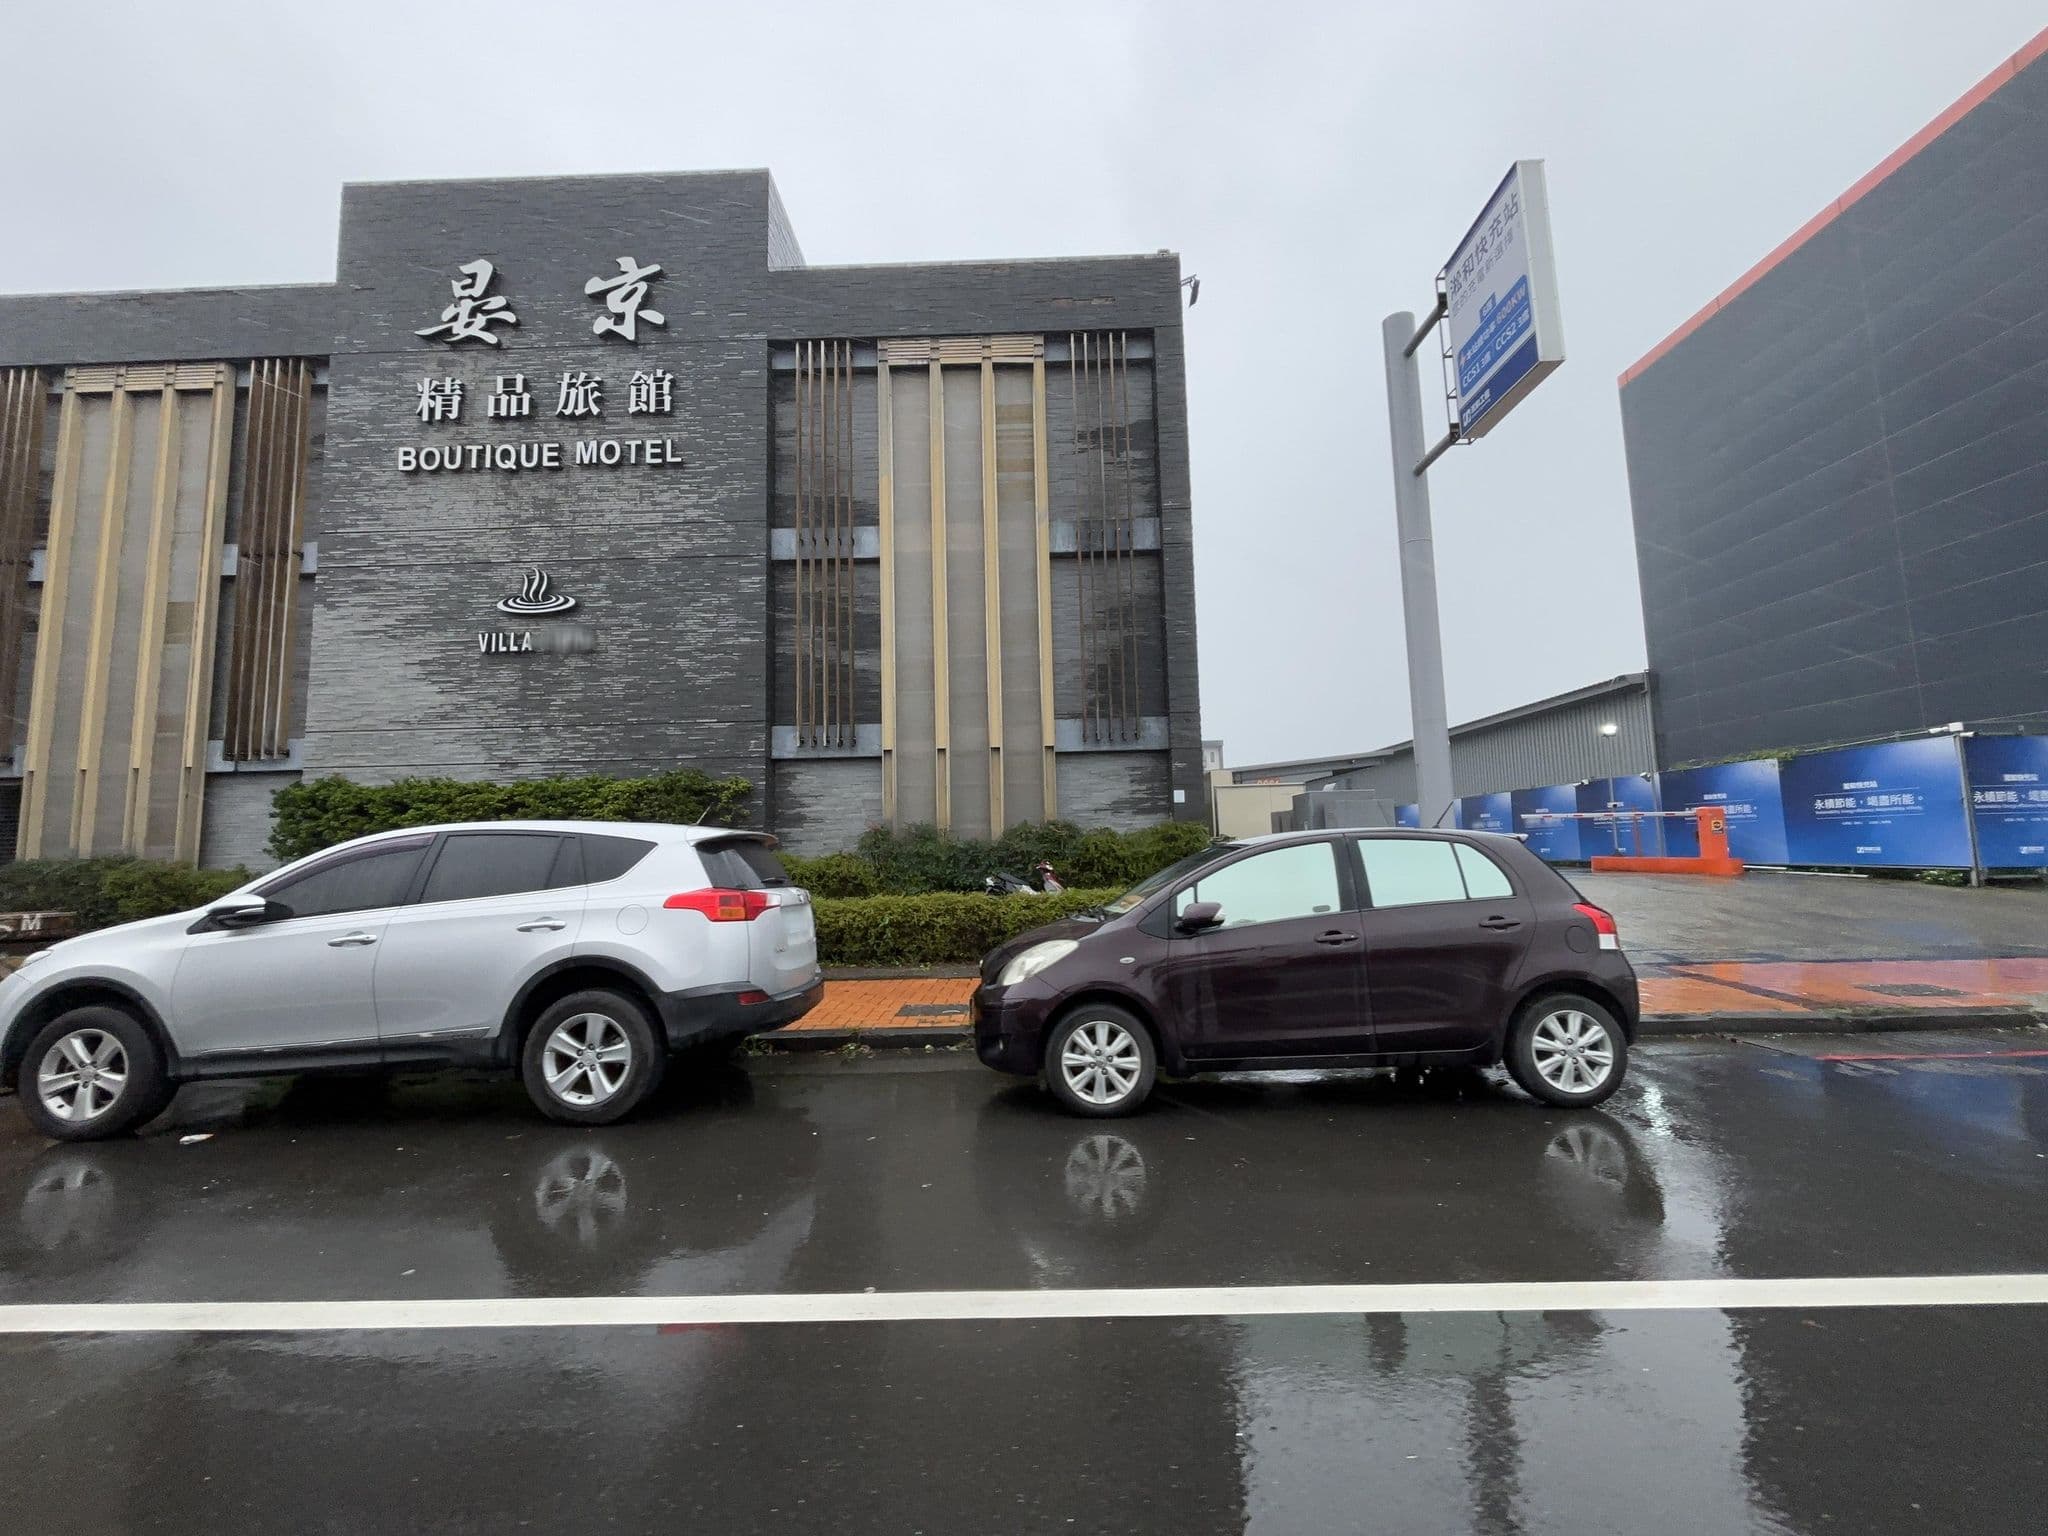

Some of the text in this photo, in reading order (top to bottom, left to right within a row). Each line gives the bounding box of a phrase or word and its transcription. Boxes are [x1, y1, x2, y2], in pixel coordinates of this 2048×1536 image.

[1496, 321, 1517, 350] CCS2
[415, 369, 674, 422] 精品旅館
[398, 439, 682, 472] BOUTIQUE MOTEL
[478, 632, 533, 652] VILLA
